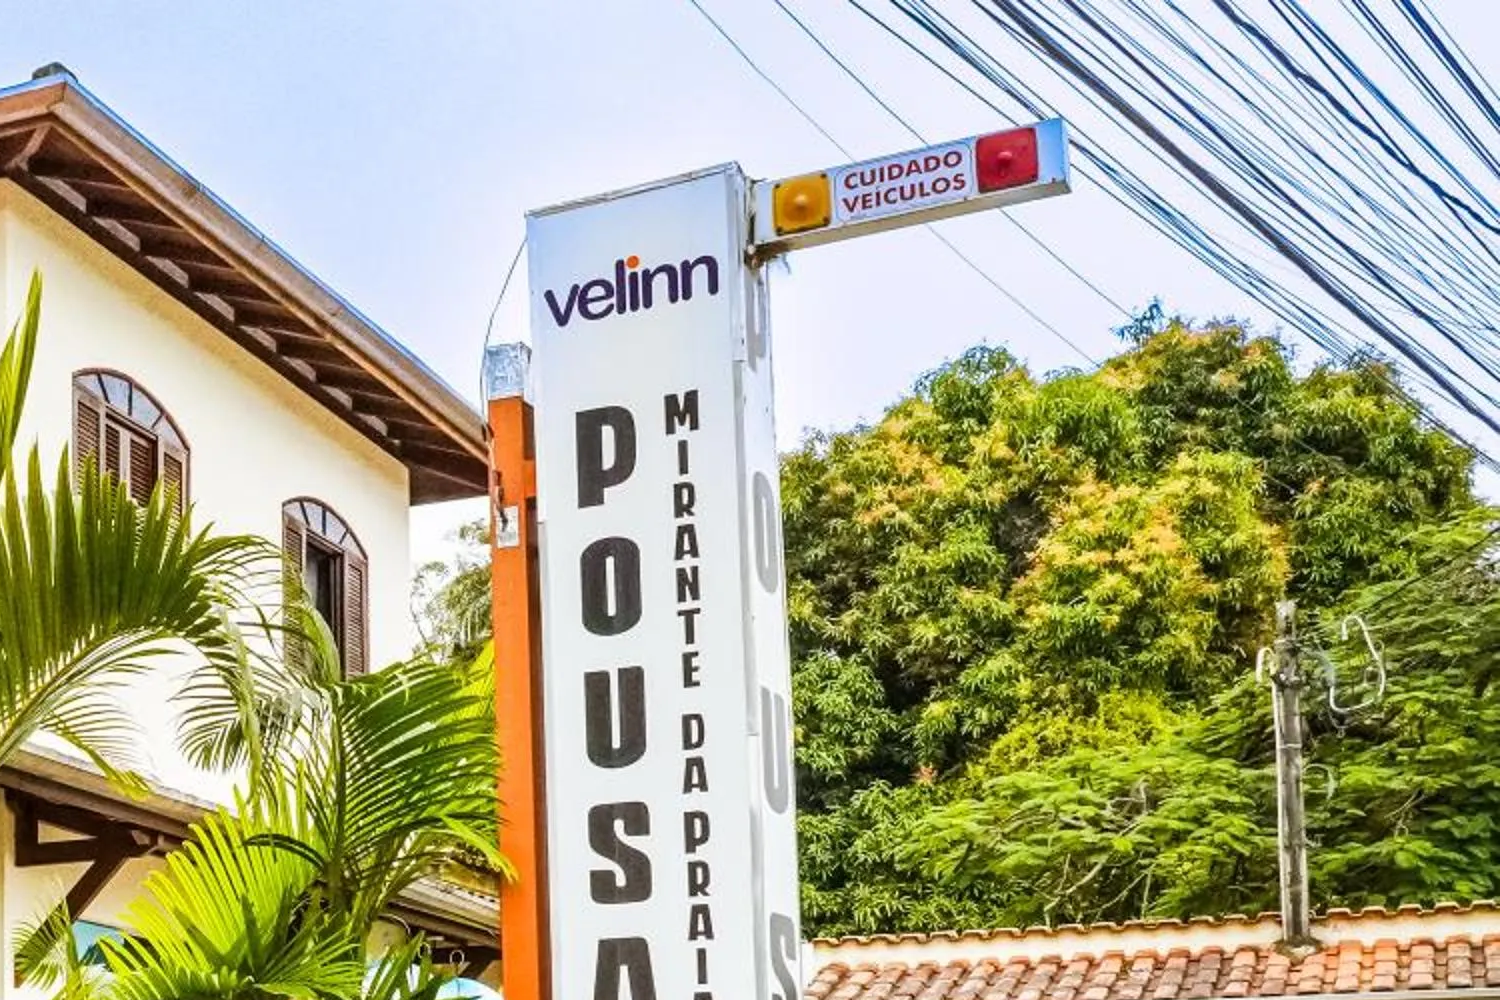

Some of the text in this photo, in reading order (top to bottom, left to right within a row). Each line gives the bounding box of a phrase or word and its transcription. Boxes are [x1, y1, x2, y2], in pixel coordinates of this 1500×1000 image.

[844, 150, 963, 189] CUIDADO
[544, 255, 719, 328] velinn
[664, 389, 701, 689] MIRANTE
[681, 713, 709, 795] DA
